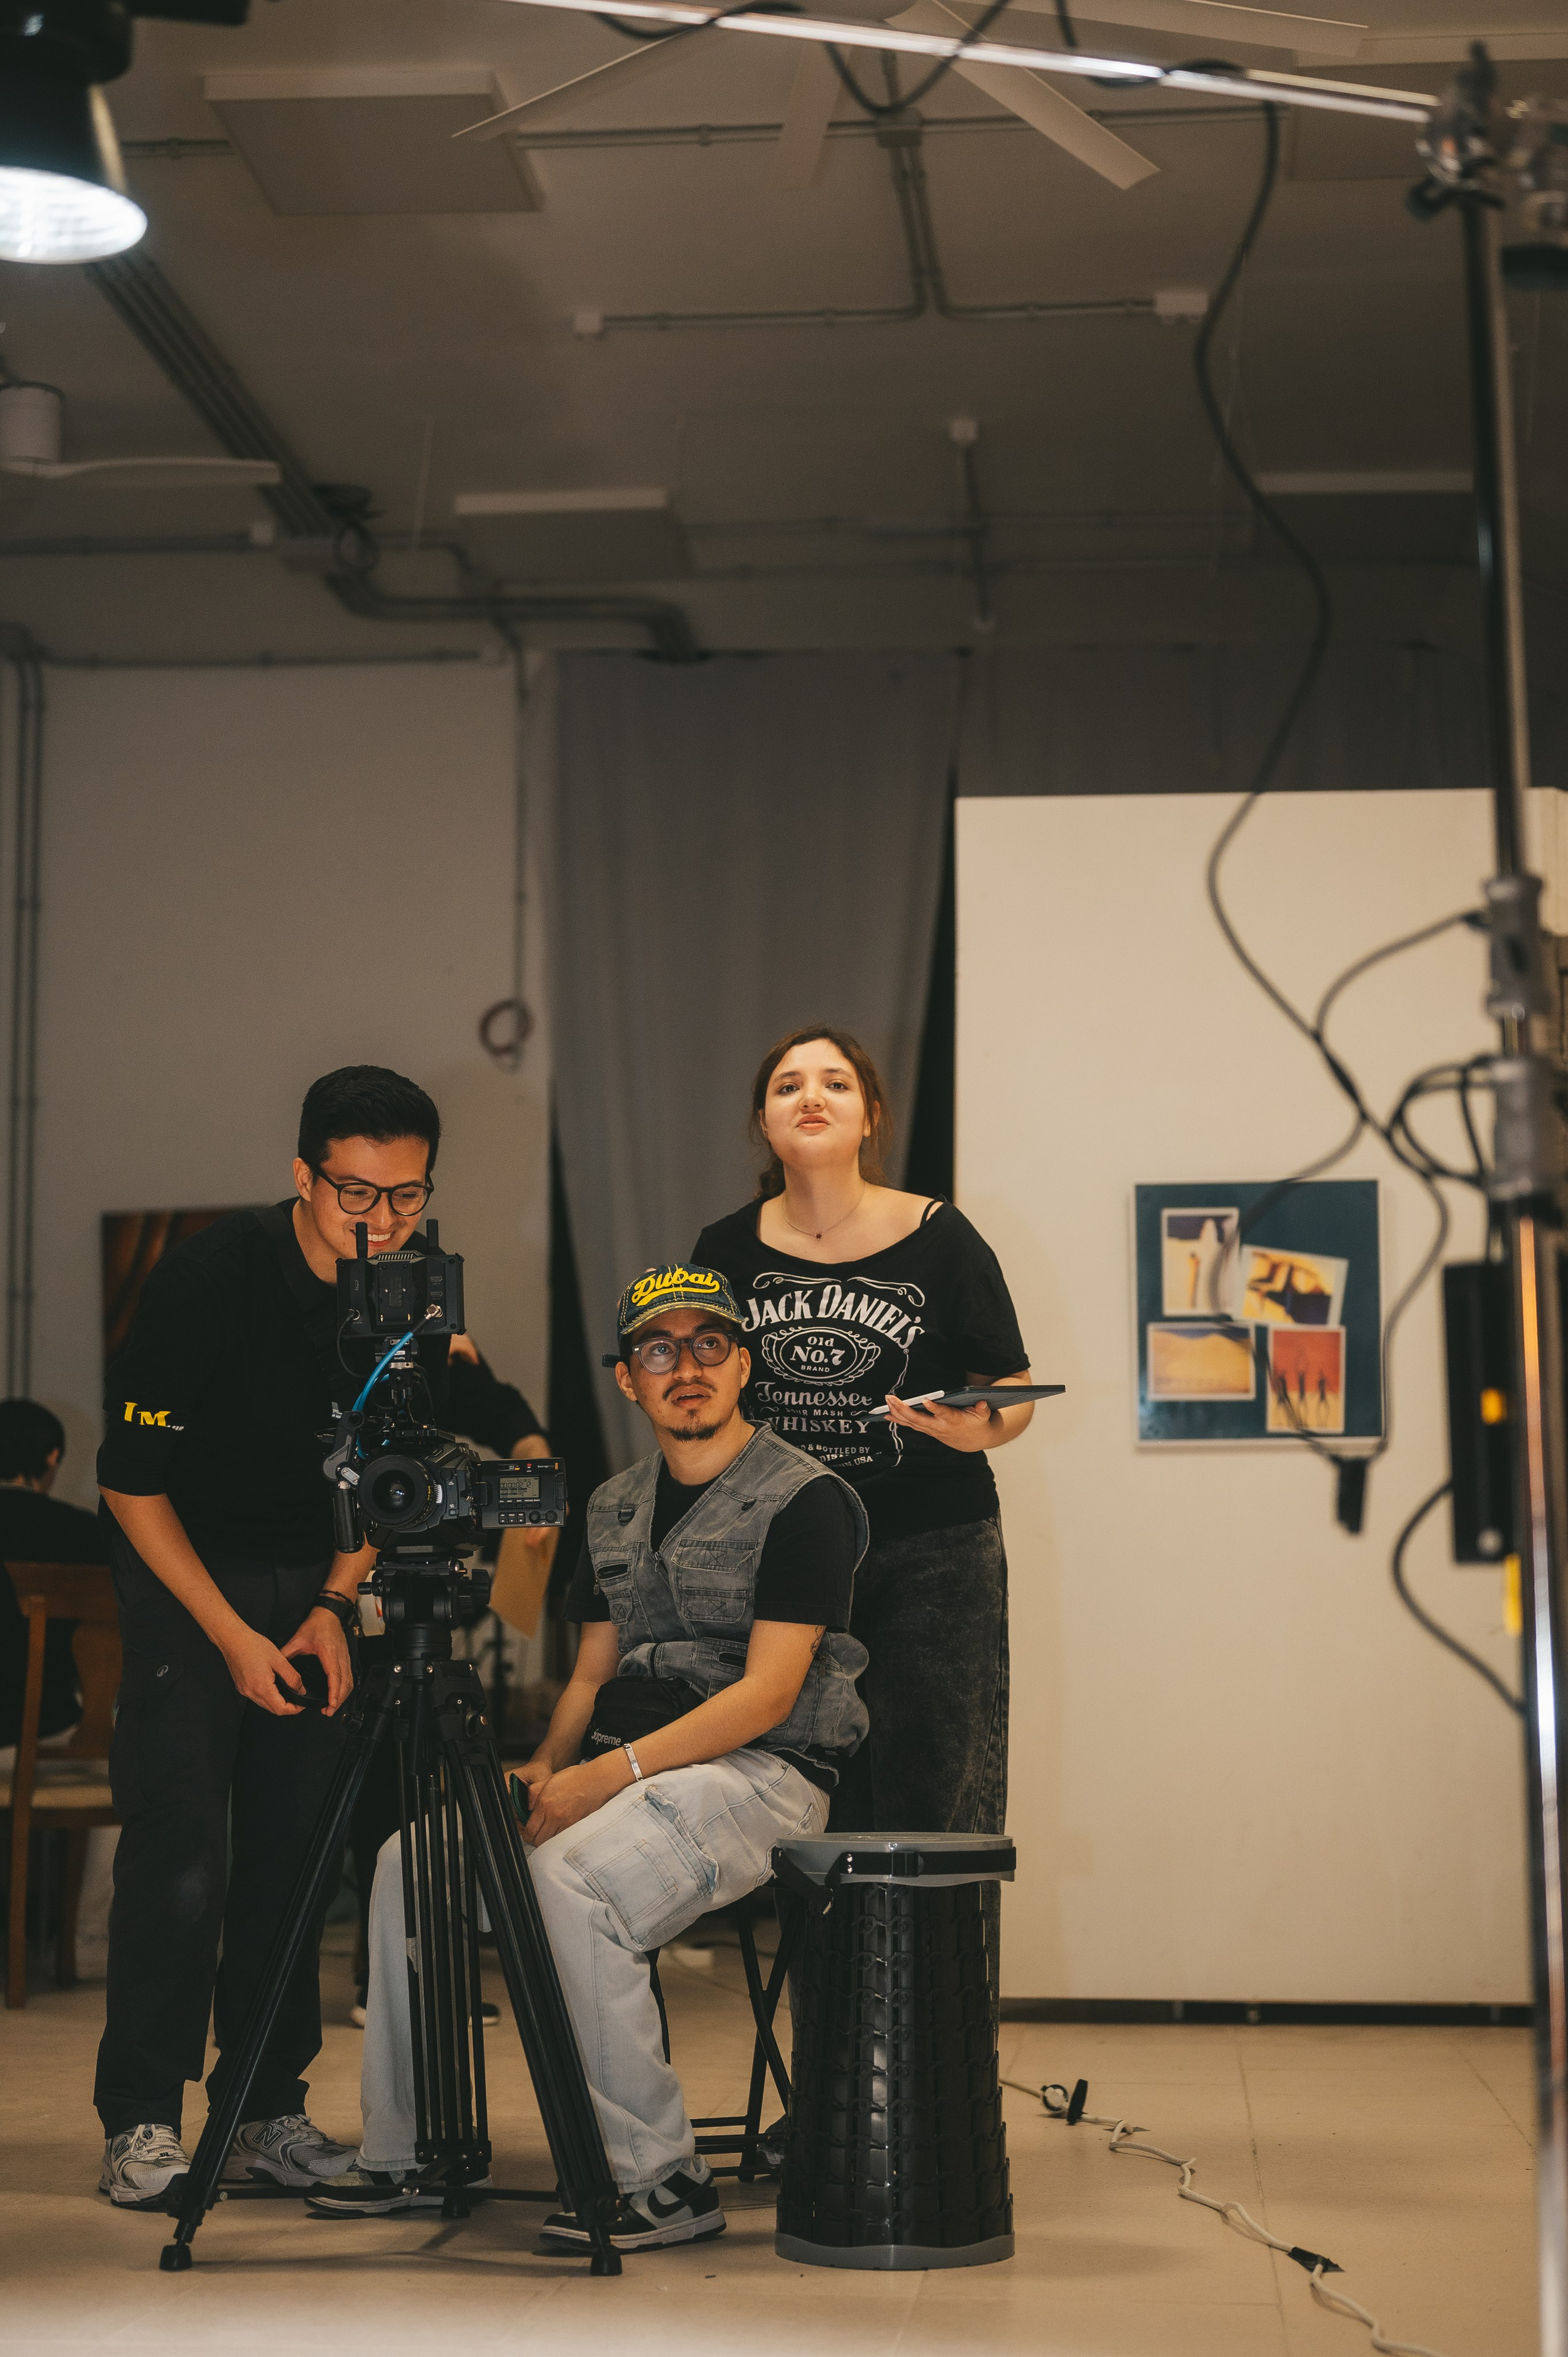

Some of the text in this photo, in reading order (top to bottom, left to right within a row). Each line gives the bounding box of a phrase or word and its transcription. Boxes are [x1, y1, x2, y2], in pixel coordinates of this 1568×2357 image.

[631, 1267, 720, 1306] Dubai
[743, 1284, 925, 1348] JACK DANIEL'S
[808, 1336, 834, 1347] Old
[755, 1382, 873, 1407] Tennessee
[816, 1444, 856, 1454] BOTTLED
[854, 1456, 873, 1465] USA
[591, 1728, 621, 1746] Supreme
